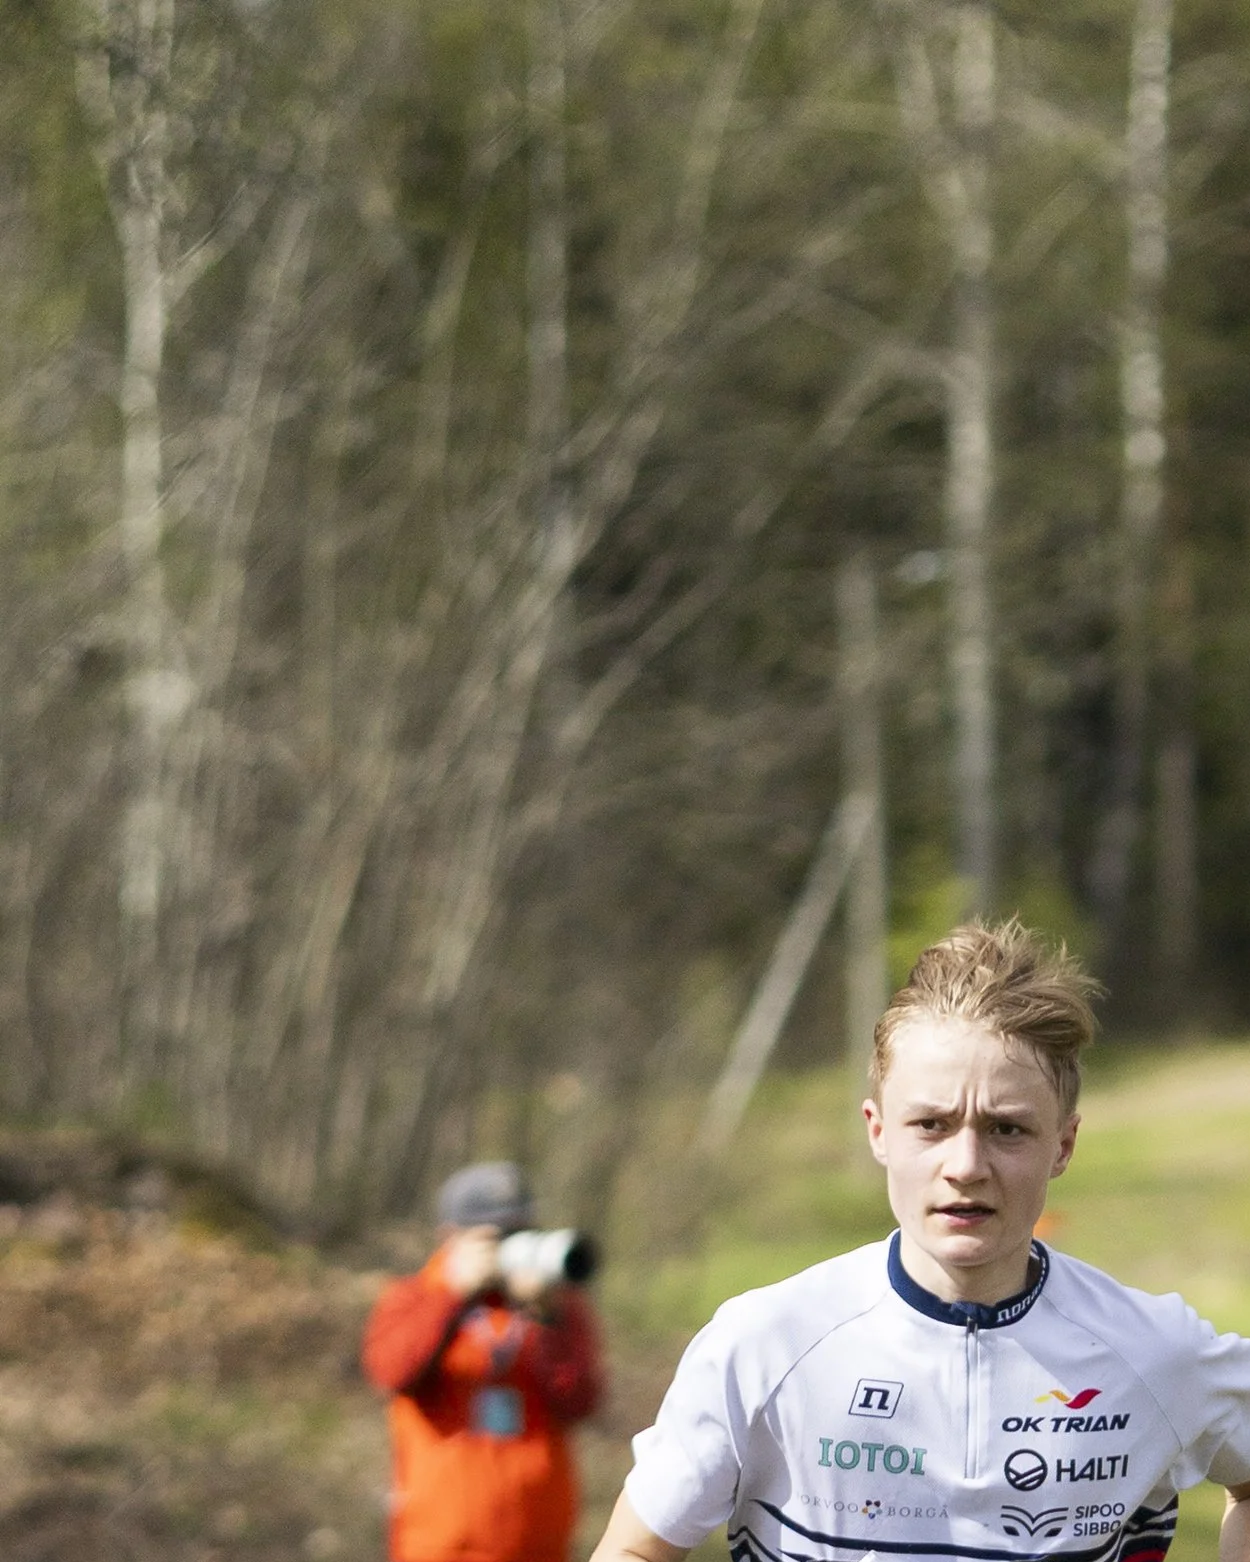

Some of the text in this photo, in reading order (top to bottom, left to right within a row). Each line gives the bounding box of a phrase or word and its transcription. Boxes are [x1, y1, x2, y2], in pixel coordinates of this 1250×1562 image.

[1001, 1413, 1131, 1433] OK TRIAN
[818, 1437, 928, 1476] IOTOI
[1056, 1454, 1129, 1483] HALTI
[796, 1492, 949, 1519] ORVOO BORGÅ
[1074, 1502, 1126, 1520] SIPOO
[1073, 1520, 1122, 1537] SIBBO
